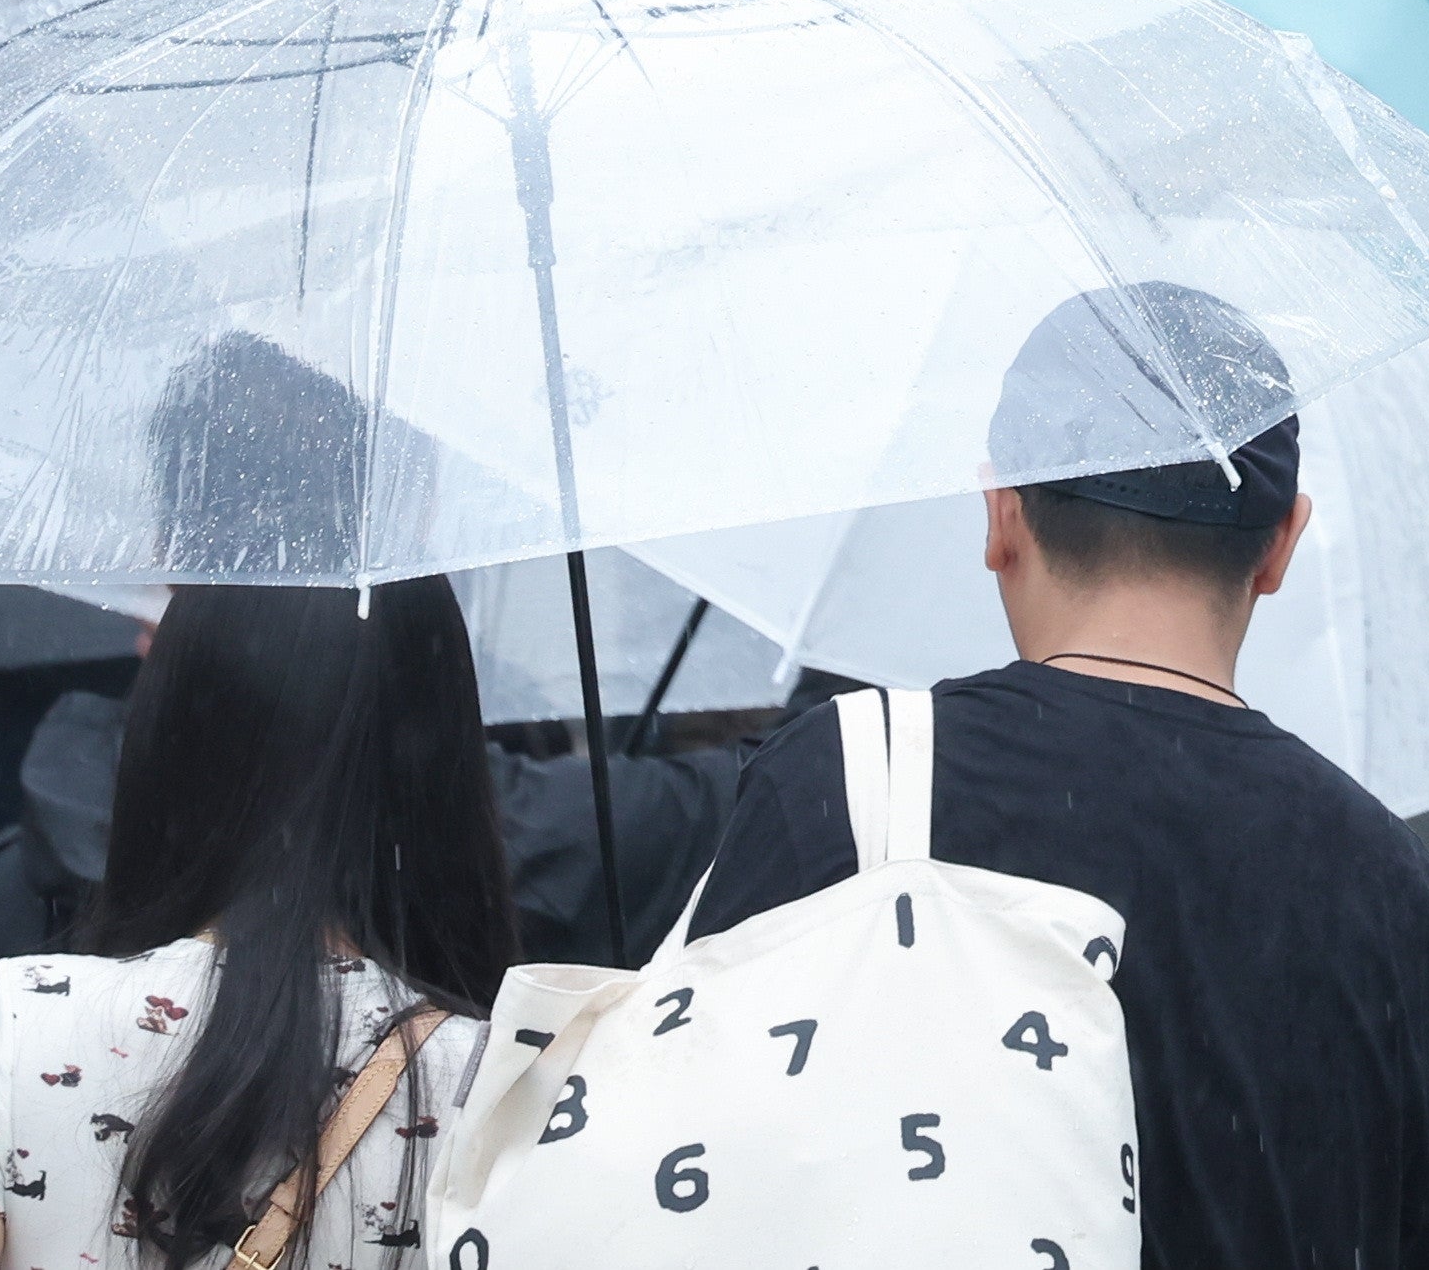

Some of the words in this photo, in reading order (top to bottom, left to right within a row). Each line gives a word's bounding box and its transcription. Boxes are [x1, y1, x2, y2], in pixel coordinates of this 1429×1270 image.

[653, 987, 694, 1036] 2
[1001, 1010, 1068, 1071] 4
[768, 1019, 818, 1076] 7
[900, 1113, 946, 1181] 5
[655, 1143, 709, 1213] 6
